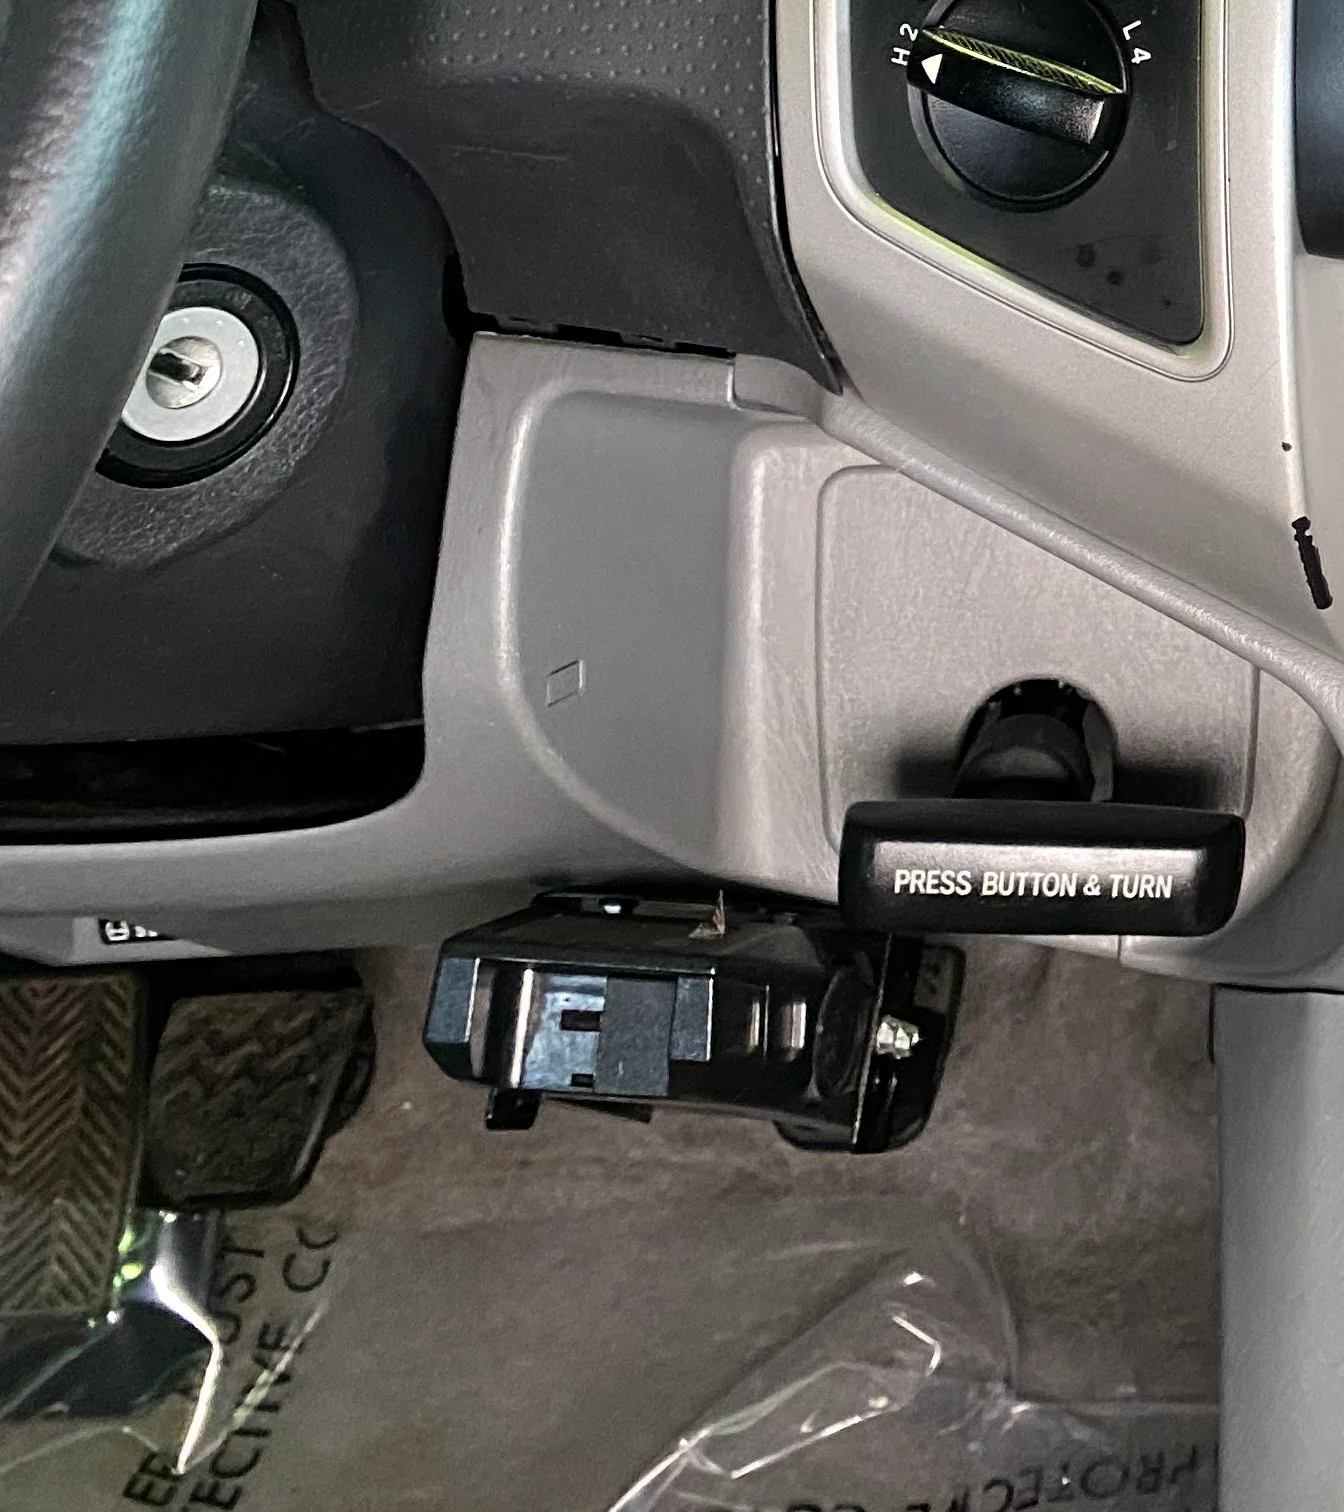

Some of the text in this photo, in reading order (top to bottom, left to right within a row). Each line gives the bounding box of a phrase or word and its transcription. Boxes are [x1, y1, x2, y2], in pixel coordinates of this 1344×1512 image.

[894, 868, 1174, 899] PRESS BUTTON & TURN
